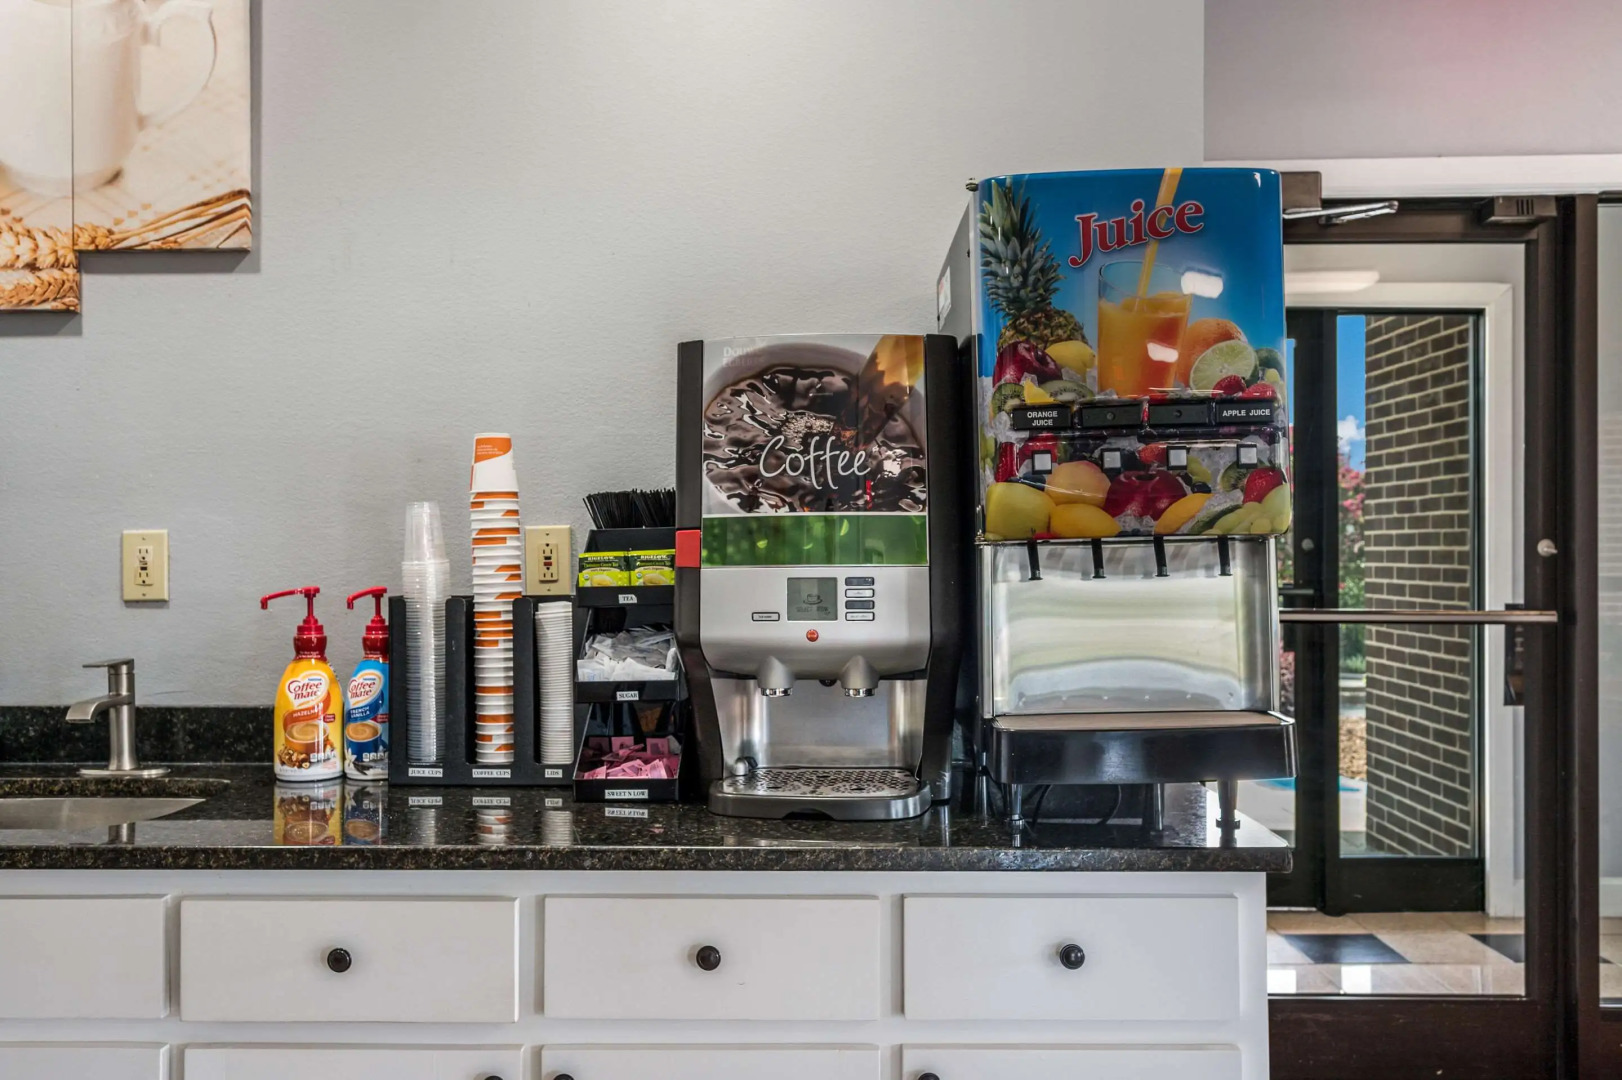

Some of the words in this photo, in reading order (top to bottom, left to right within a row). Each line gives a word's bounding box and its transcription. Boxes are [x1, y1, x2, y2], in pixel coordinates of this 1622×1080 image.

[1068, 198, 1204, 268] Juice
[1027, 410, 1058, 418] ORANGE
[1222, 409, 1246, 417] APPLE
[1032, 418, 1053, 427] JUICE
[759, 435, 871, 490] Coffee
[288, 680, 322, 693] Coffee
[348, 679, 376, 694] Coffee
[294, 690, 318, 700] mate
[350, 690, 372, 699] mate
[293, 709, 320, 717] HAZELN
[350, 706, 370, 714] FRENCH
[350, 711, 370, 719] VANILLA
